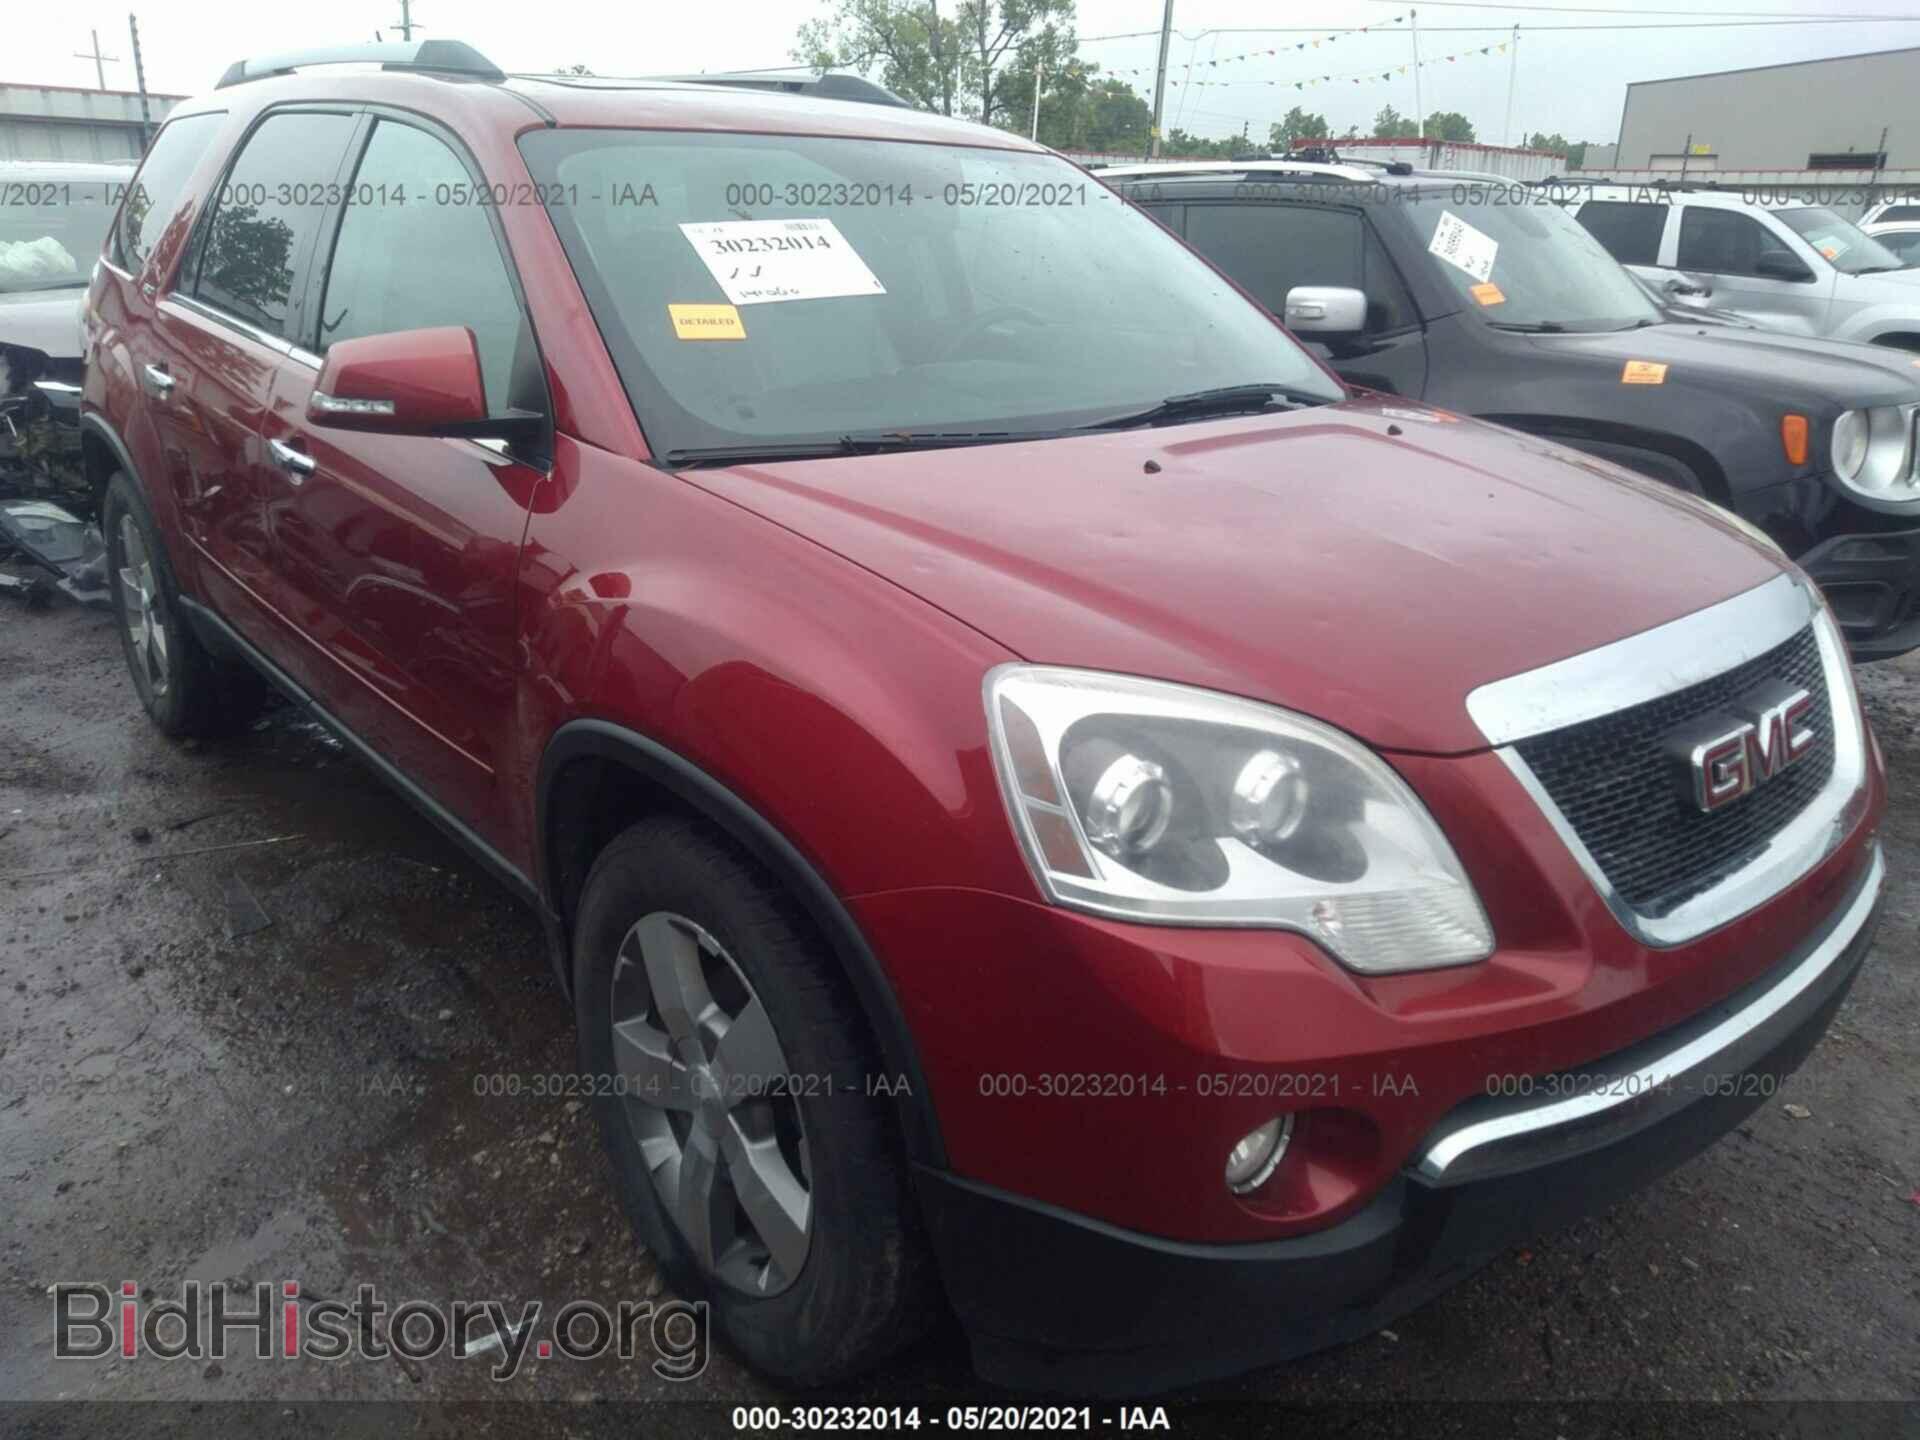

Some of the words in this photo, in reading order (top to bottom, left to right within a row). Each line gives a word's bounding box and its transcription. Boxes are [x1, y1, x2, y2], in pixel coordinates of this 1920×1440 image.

[710, 234, 832, 255] 30232014
[679, 318, 735, 326] DETAILED
[1691, 689, 1816, 812] GMC
